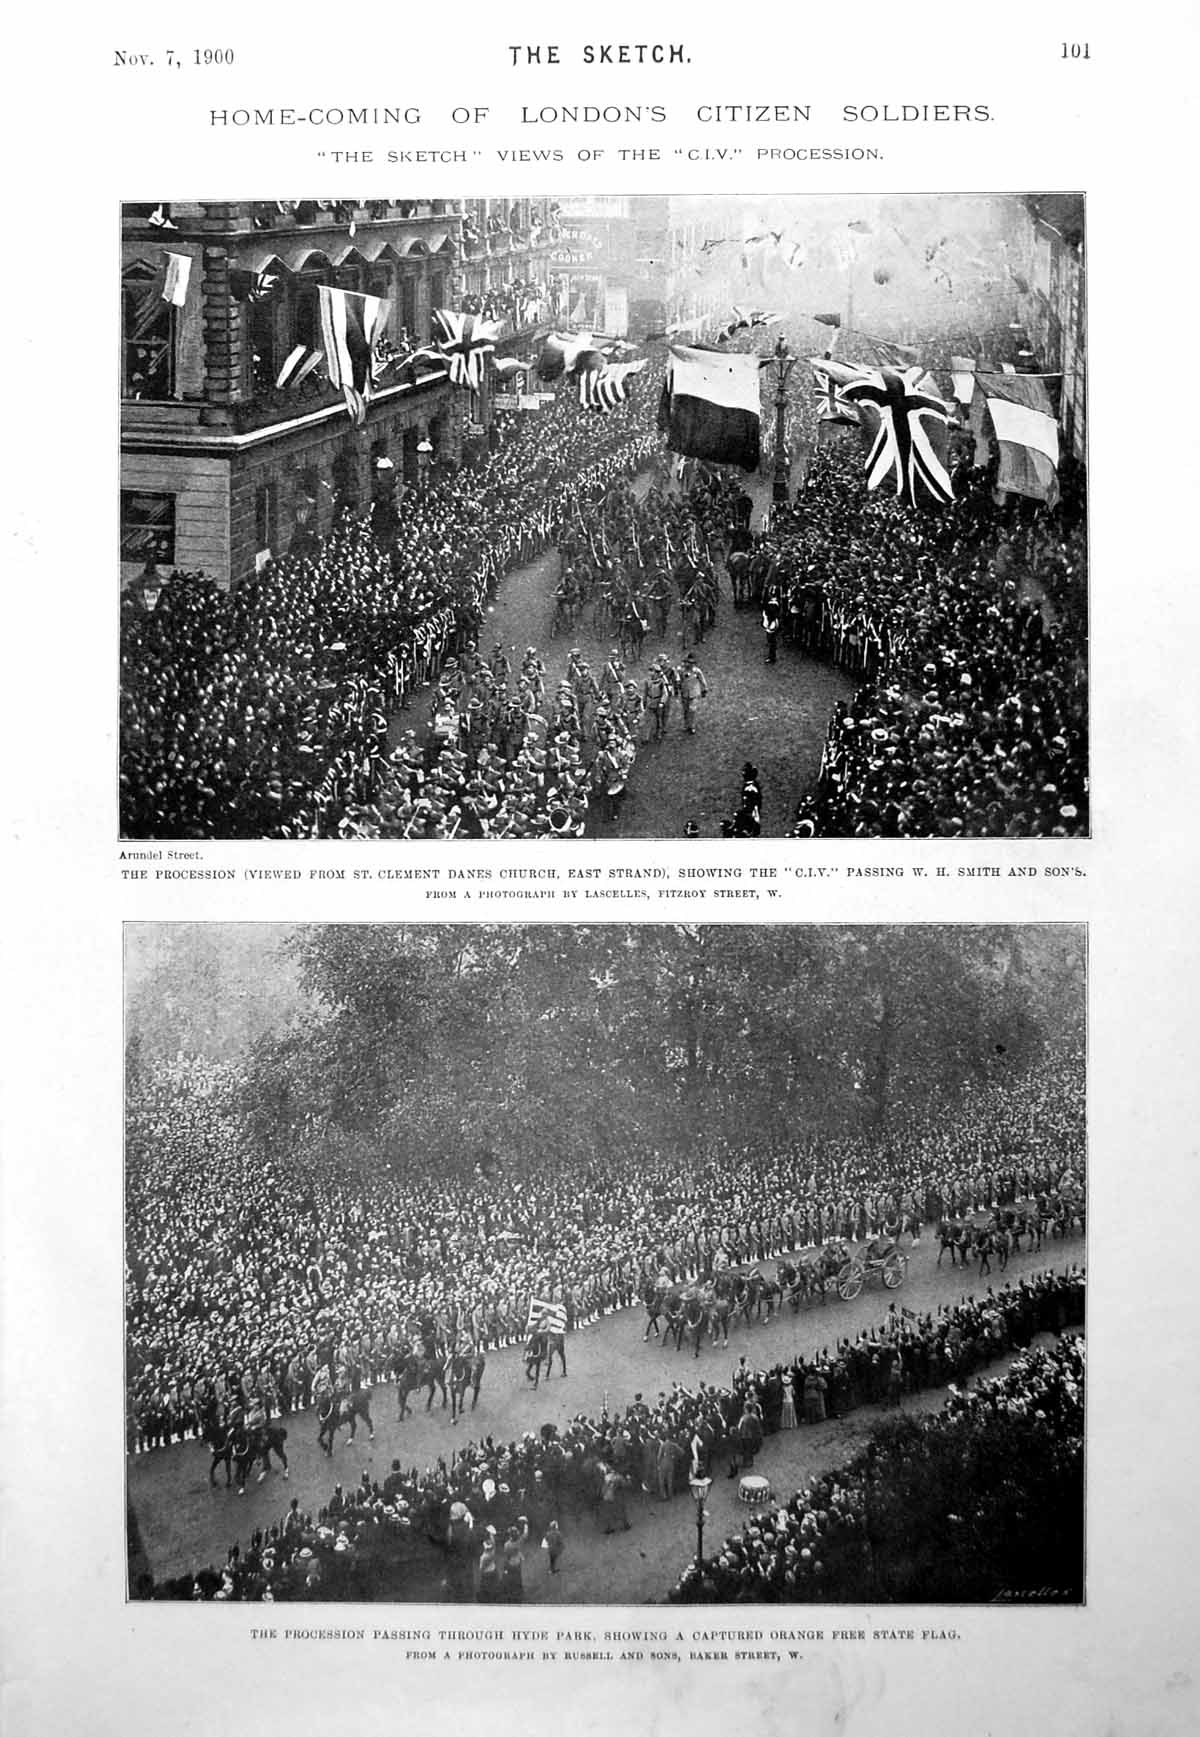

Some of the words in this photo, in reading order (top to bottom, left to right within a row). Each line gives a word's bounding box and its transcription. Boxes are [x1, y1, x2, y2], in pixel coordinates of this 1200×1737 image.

[165, 49, 181, 69] 7,
[193, 48, 235, 65] 1900
[508, 45, 561, 67] THE
[583, 43, 692, 64] SKETCH.
[1060, 42, 1091, 60] 101
[209, 107, 421, 127] HOME-COMING
[451, 107, 490, 124] OF
[520, 105, 667, 124] LONDON'S
[696, 105, 812, 123] CITIZEN
[843, 104, 995, 123] SOLDIERS.
[496, 149, 564, 162] VIEWS
[577, 149, 605, 162] OF
[617, 148, 661, 161] THE
[757, 147, 884, 161] PROCESSION.
[118, 850, 163, 861] Arundel
[167, 850, 204, 861] Street.
[120, 869, 148, 880] THE
[155, 869, 236, 880] PROCESSION
[244, 868, 302, 881] (VIEWED
[309, 869, 345, 880] FROM
[353, 869, 373, 880] ST.
[377, 869, 441, 880] CLEMENT
[447, 868, 493, 880] DANES
[567, 868, 602, 879] EAST
[608, 867, 670, 880] STRAND),
[678, 867, 743, 879] SHOWING
[749, 867, 777, 878] THE
[847, 867, 905, 878] PASSING
[911, 867, 928, 878] W.
[935, 866, 950, 877] H.
[957, 866, 1001, 877] SMITH
[1007, 866, 1038, 877] AND
[1043, 866, 1087, 878] SON'S.
[425, 890, 457, 899] FROM
[463, 890, 472, 899] A
[478, 890, 556, 899] PHOTOGRAPH
[563, 889, 578, 899] BY
[584, 889, 651, 901] LASCELLES,
[657, 889, 707, 899] FITZROY
[713, 889, 760, 901] STREET,
[767, 889, 782, 898] W.
[250, 1628, 277, 1640] THE
[284, 1629, 365, 1640] PROCESSION
[373, 1630, 431, 1641] PASSING
[438, 1630, 503, 1641] THROUGH
[512, 1631, 549, 1641] HYDE
[604, 1631, 668, 1641] SHOWING
[675, 1631, 684, 1641] A
[692, 1630, 764, 1641] CAPTURED
[769, 1630, 824, 1641] ORANGE
[831, 1630, 865, 1641] FREE
[872, 1629, 915, 1640] STATE
[921, 1629, 961, 1641] FLAG.
[405, 1651, 437, 1660] FROM
[444, 1651, 451, 1660] A
[458, 1651, 535, 1660] PHOTOGRAPH
[542, 1652, 556, 1661] BY
[564, 1651, 614, 1661] RUSSELL
[620, 1651, 644, 1661] AND
[650, 1651, 681, 1663] SONS,
[689, 1651, 729, 1661] BAKER
[734, 1651, 781, 1662] STREET,
[788, 1650, 803, 1660] W.
